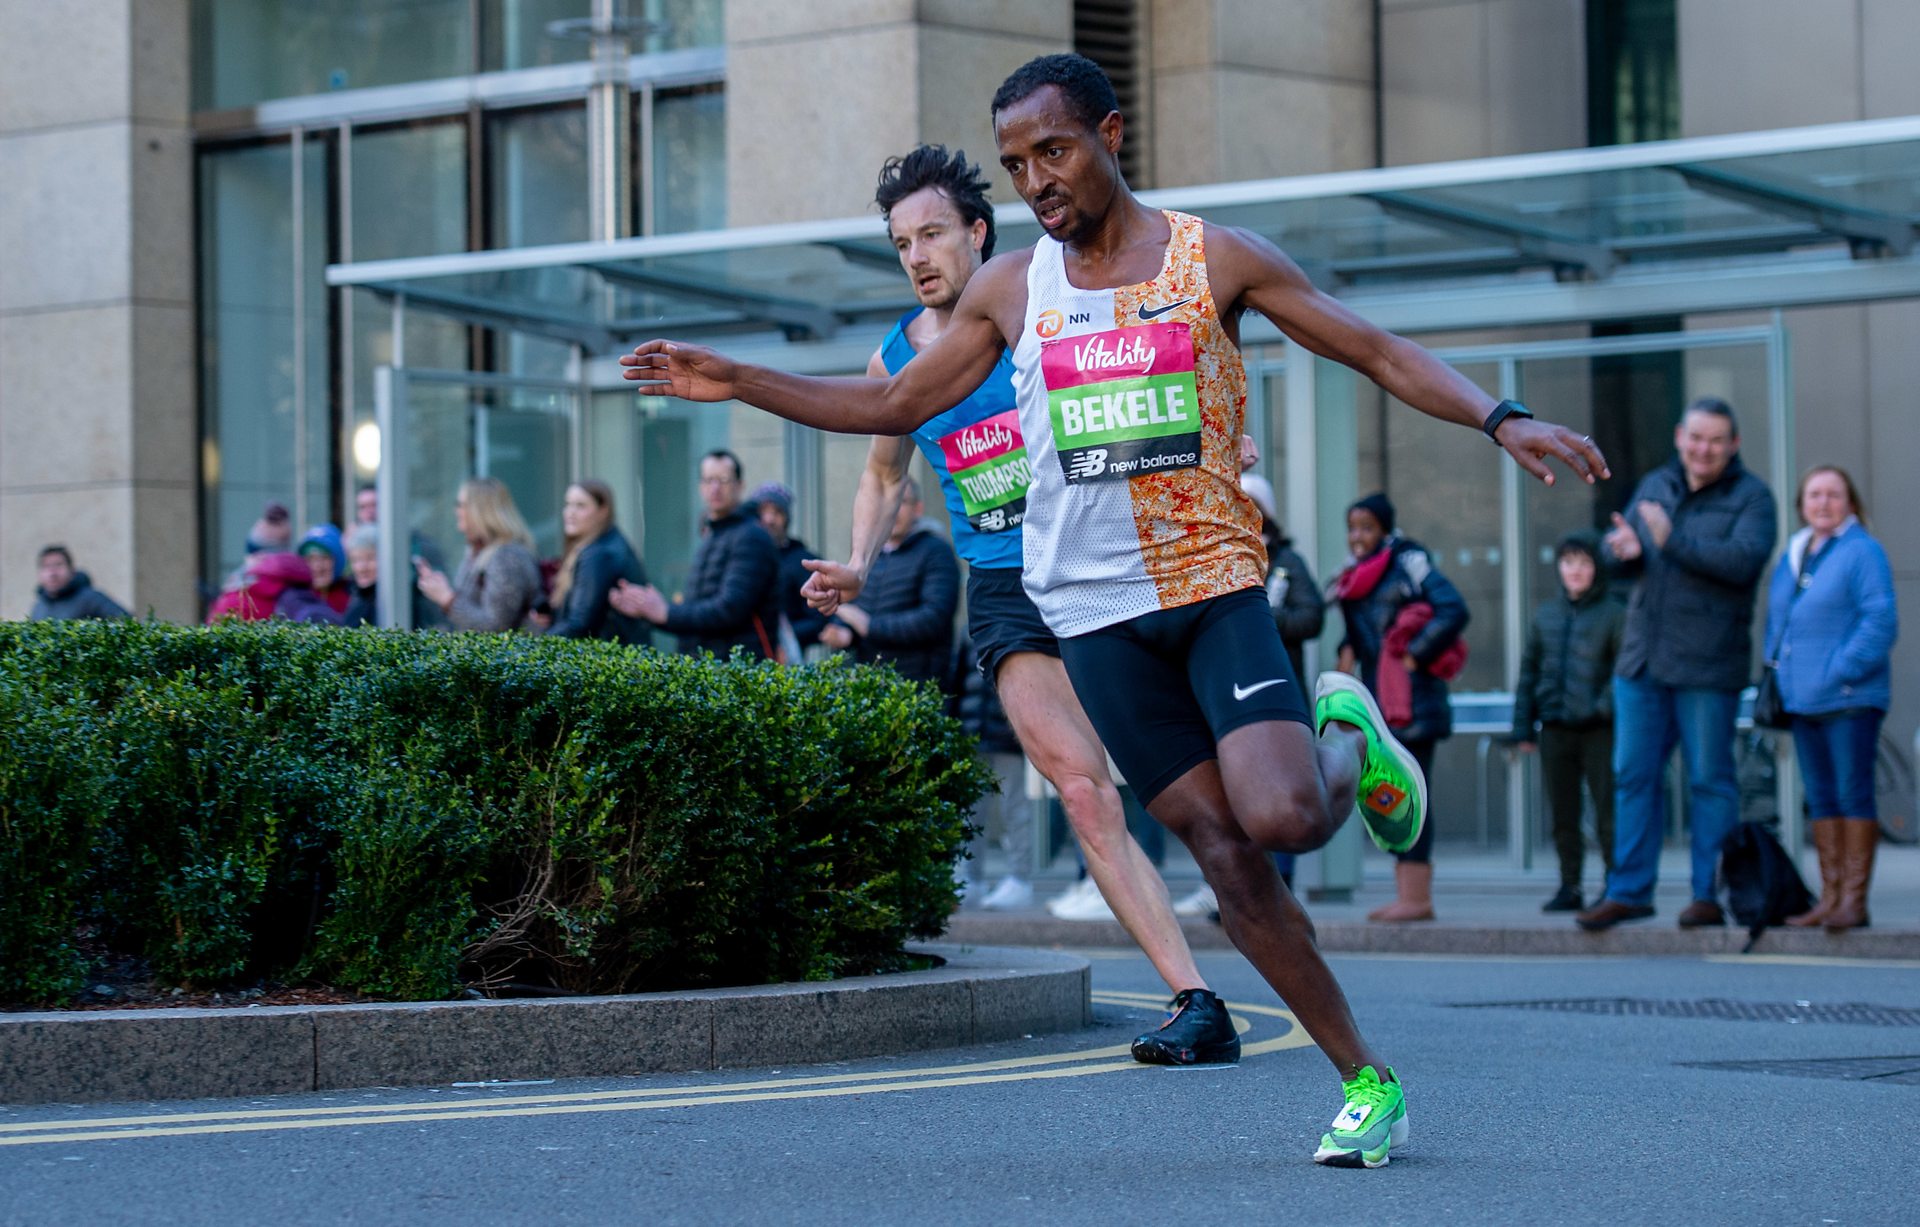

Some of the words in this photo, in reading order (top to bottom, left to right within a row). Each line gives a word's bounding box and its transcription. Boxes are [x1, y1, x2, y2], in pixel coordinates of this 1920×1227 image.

[1069, 313, 1090, 324] NN
[1074, 335, 1156, 374] Vitality
[1060, 385, 1188, 437] BEKELE
[955, 422, 1013, 459] Vitality
[1110, 459, 1139, 474] new
[1140, 451, 1197, 470] balance
